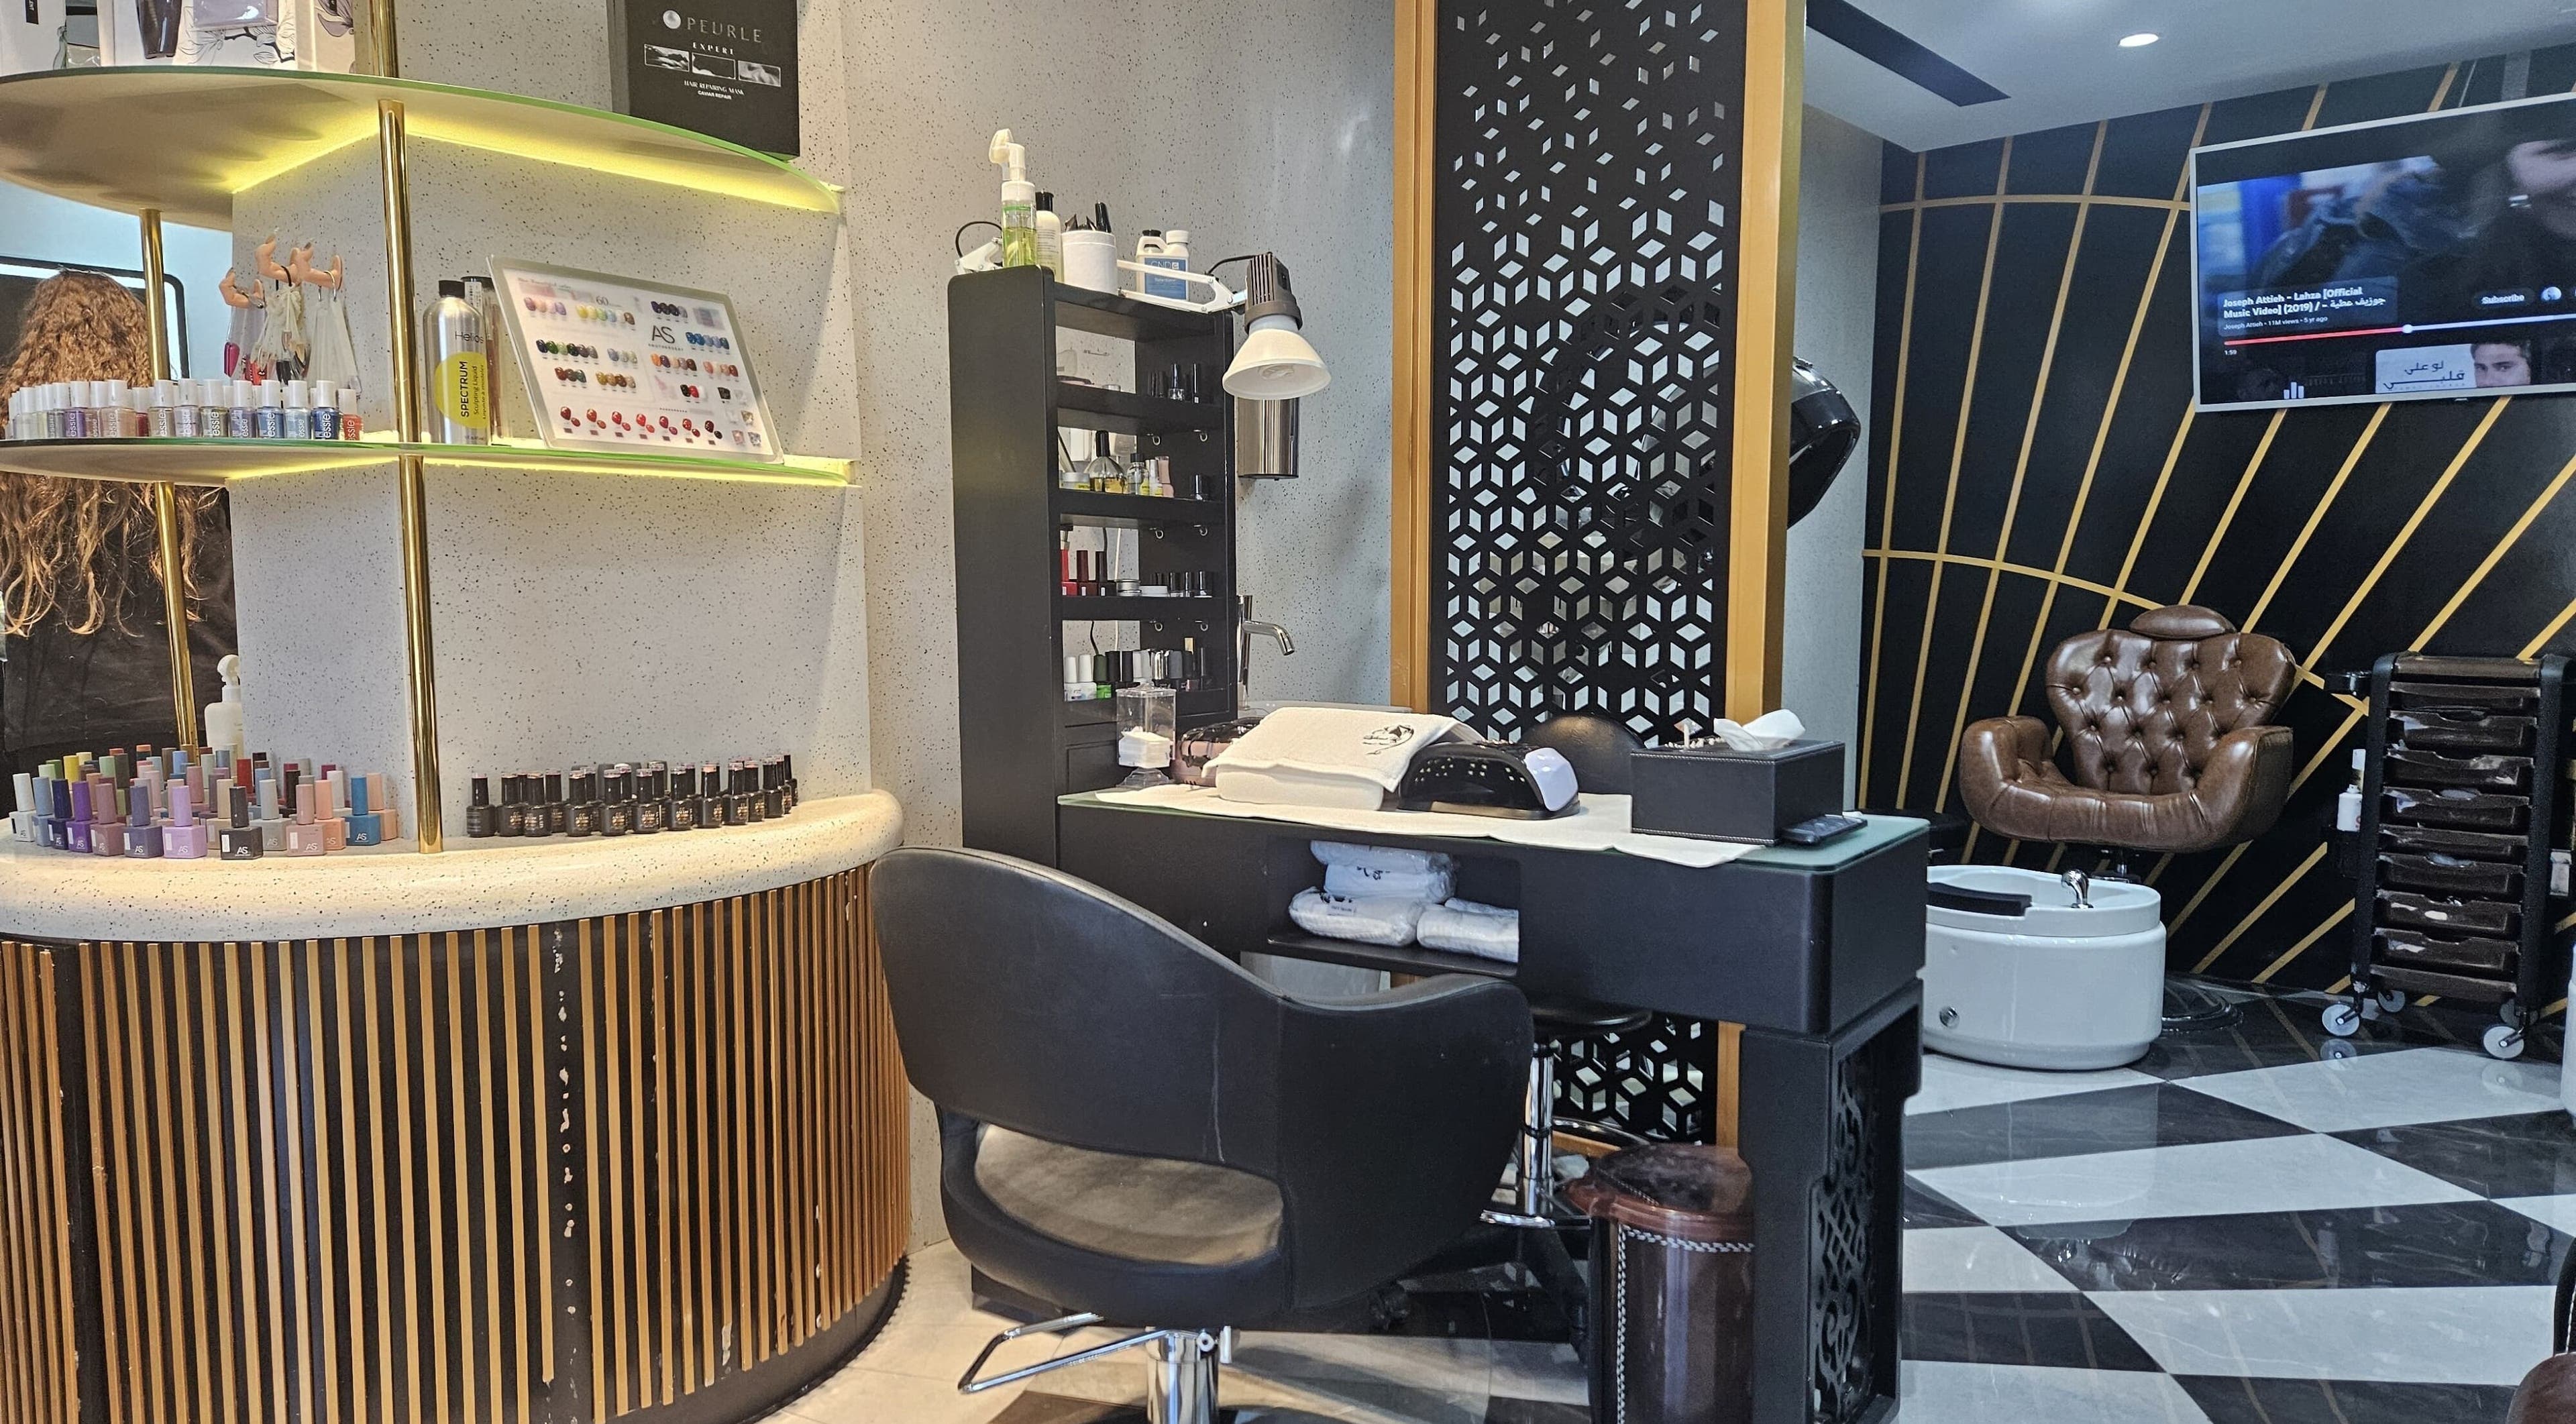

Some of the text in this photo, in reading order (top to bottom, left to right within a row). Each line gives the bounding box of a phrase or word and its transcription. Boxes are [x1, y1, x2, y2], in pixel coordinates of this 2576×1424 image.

[687, 17, 761, 43] PEURLE
[692, 42, 735, 56] EXPERT
[684, 80, 698, 89] HAIR
[2223, 298, 2254, 308] Joseph
[2294, 292, 2322, 301] Lahza
[2323, 286, 2363, 300] [Official
[2481, 294, 2524, 305] Subscribe
[2223, 309, 2251, 319] Music
[2252, 305, 2283, 317] Video]
[2284, 302, 2312, 315] (2019)
[460, 360, 470, 418] SPECTRUM
[472, 387, 480, 415] Sculpting
[211, 411, 221, 437] essie
[268, 413, 276, 437] essie
[323, 413, 331, 438] essie
[135, 845, 144, 853] AS
[178, 845, 189, 853] AS
[306, 842, 318, 851] AS
